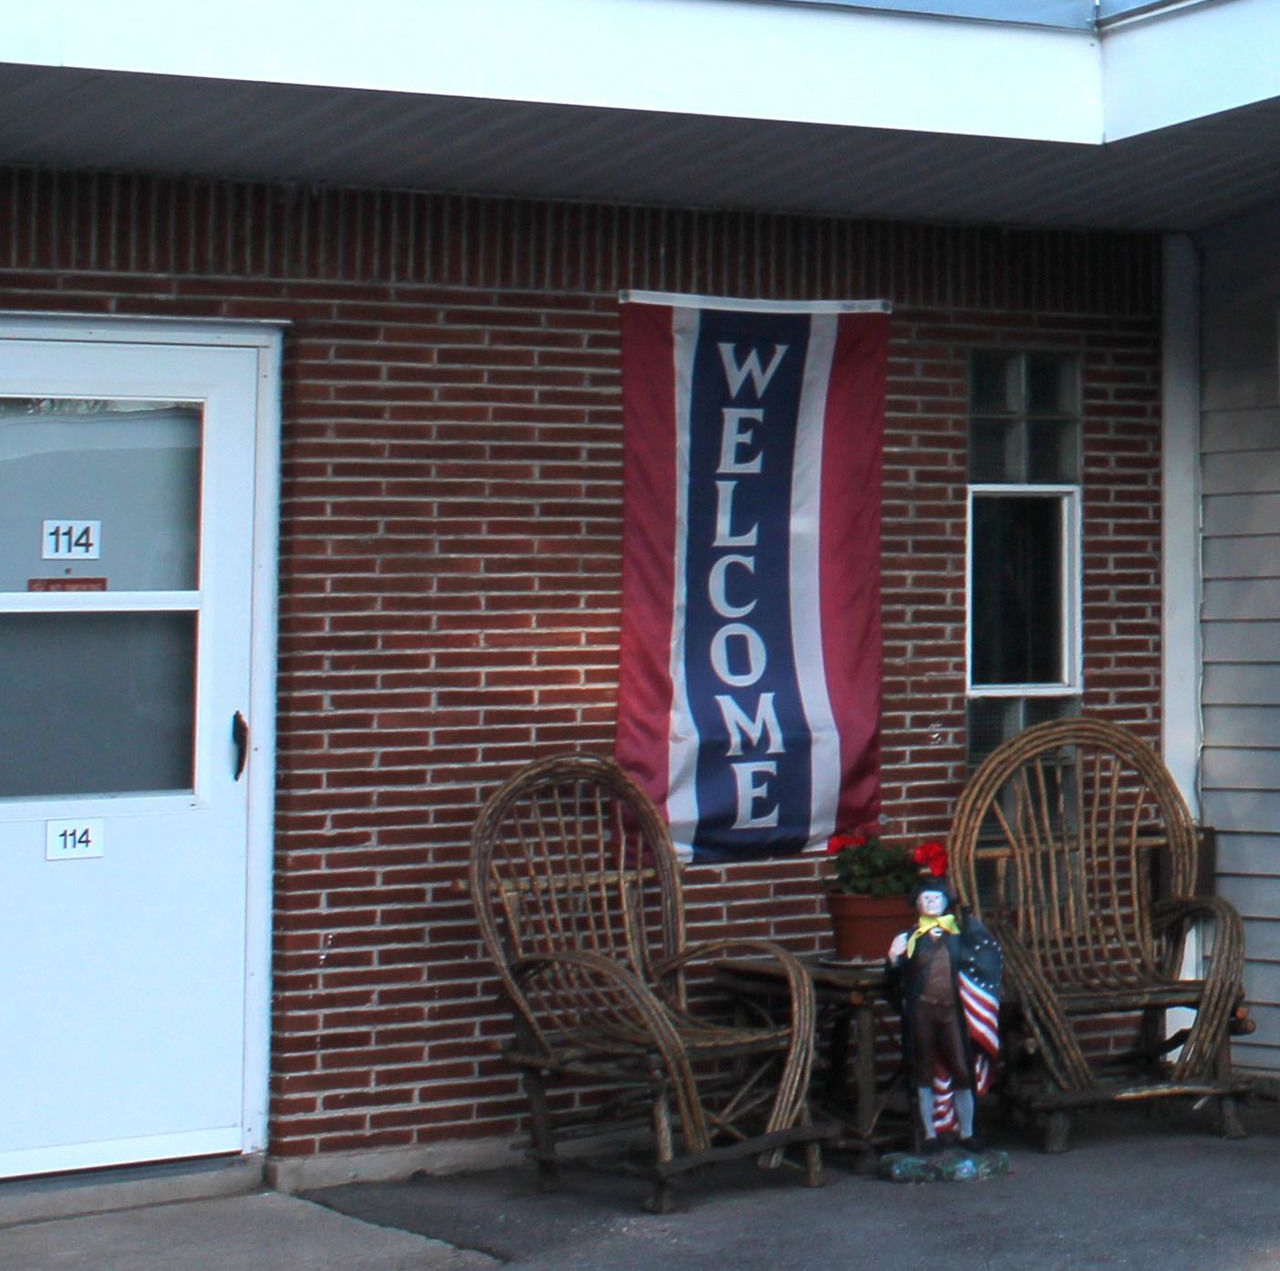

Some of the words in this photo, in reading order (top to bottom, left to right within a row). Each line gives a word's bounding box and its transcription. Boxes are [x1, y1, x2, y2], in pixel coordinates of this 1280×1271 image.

[48, 525, 94, 554] 114
[708, 342, 789, 830] WELCOME
[58, 827, 92, 849] 114
